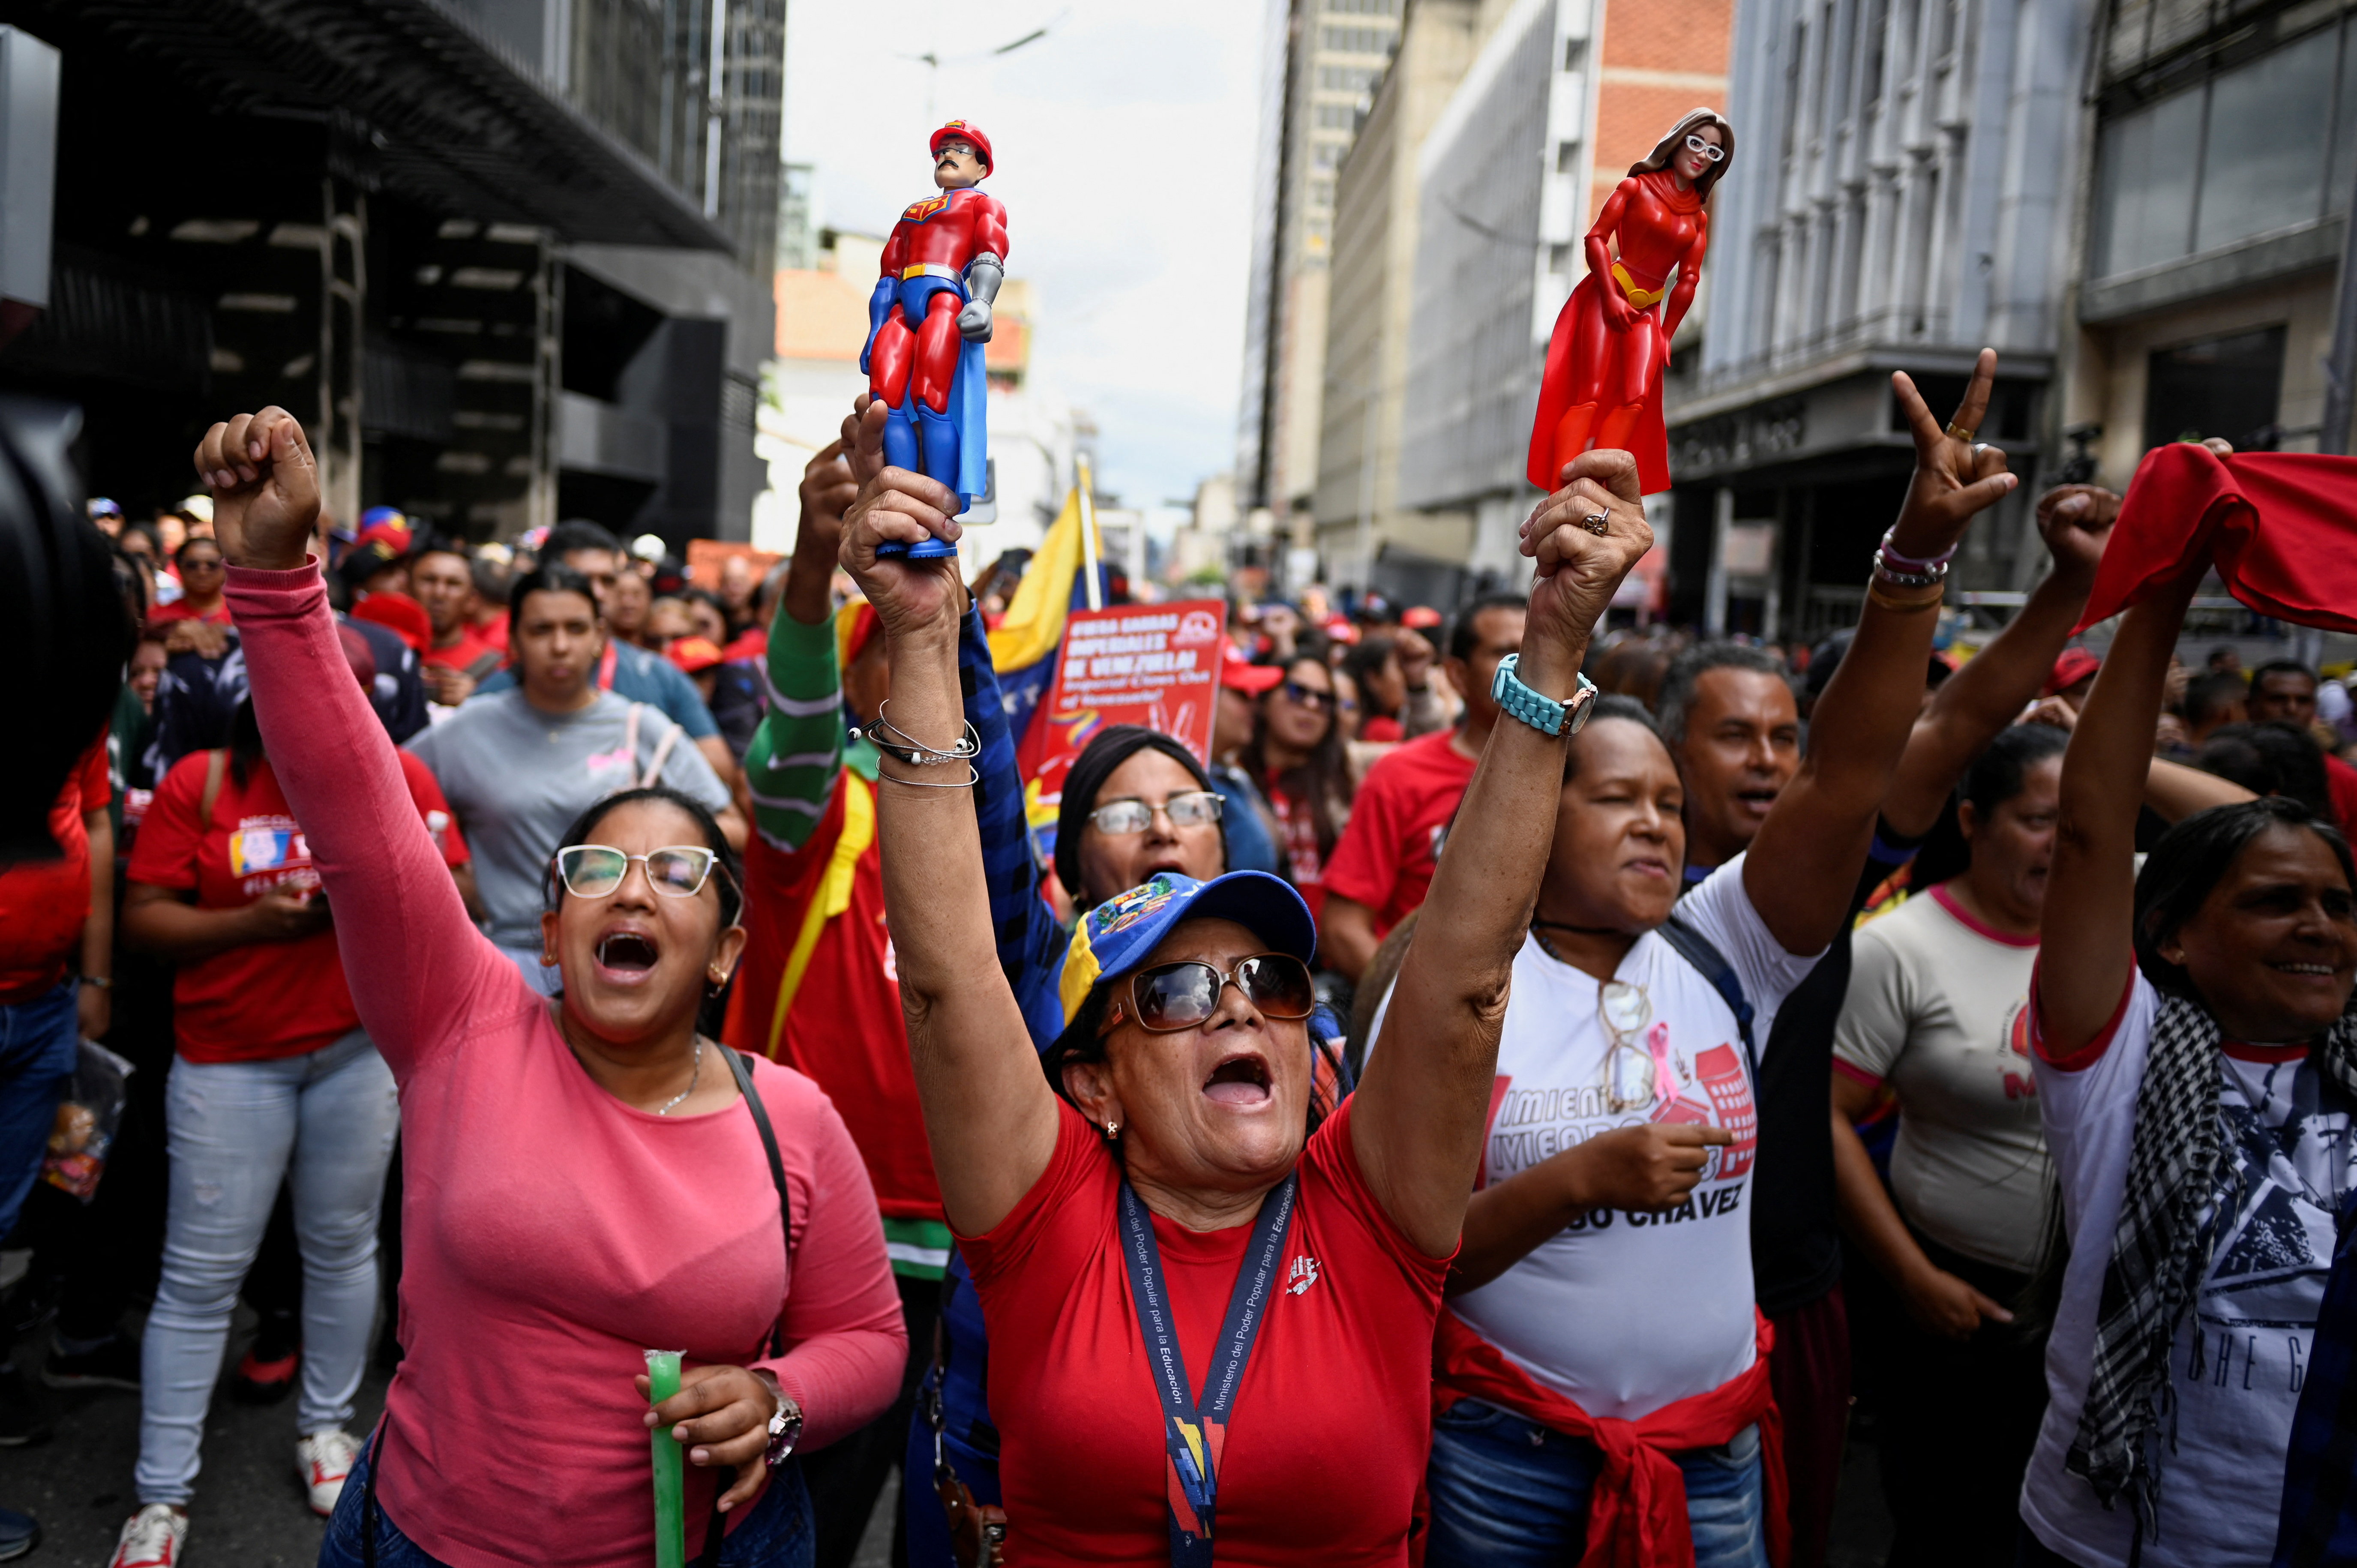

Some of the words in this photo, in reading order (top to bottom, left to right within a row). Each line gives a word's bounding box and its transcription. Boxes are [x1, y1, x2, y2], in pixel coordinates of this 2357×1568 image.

[1500, 1079, 1654, 1127] IMIENO
[1125, 1183, 1137, 1216] inisterio
[1272, 1184, 1295, 1233] Educación
[1626, 1182, 1744, 1227] CHAVEZ
[1130, 1218, 1142, 1232] del
[1267, 1233, 1278, 1243] la
[1134, 1234, 1148, 1264] Poder
[1262, 1244, 1275, 1268] para
[1142, 1267, 1158, 1307] Popular
[1246, 1268, 1267, 1307] Popular
[1149, 1310, 1164, 1332] para
[1235, 1308, 1254, 1340] Poder
[1158, 1335, 1168, 1344] la
[1231, 1341, 1244, 1358] del
[1160, 1348, 1182, 1404] Educación
[1213, 1360, 1238, 1410] Ministerio
